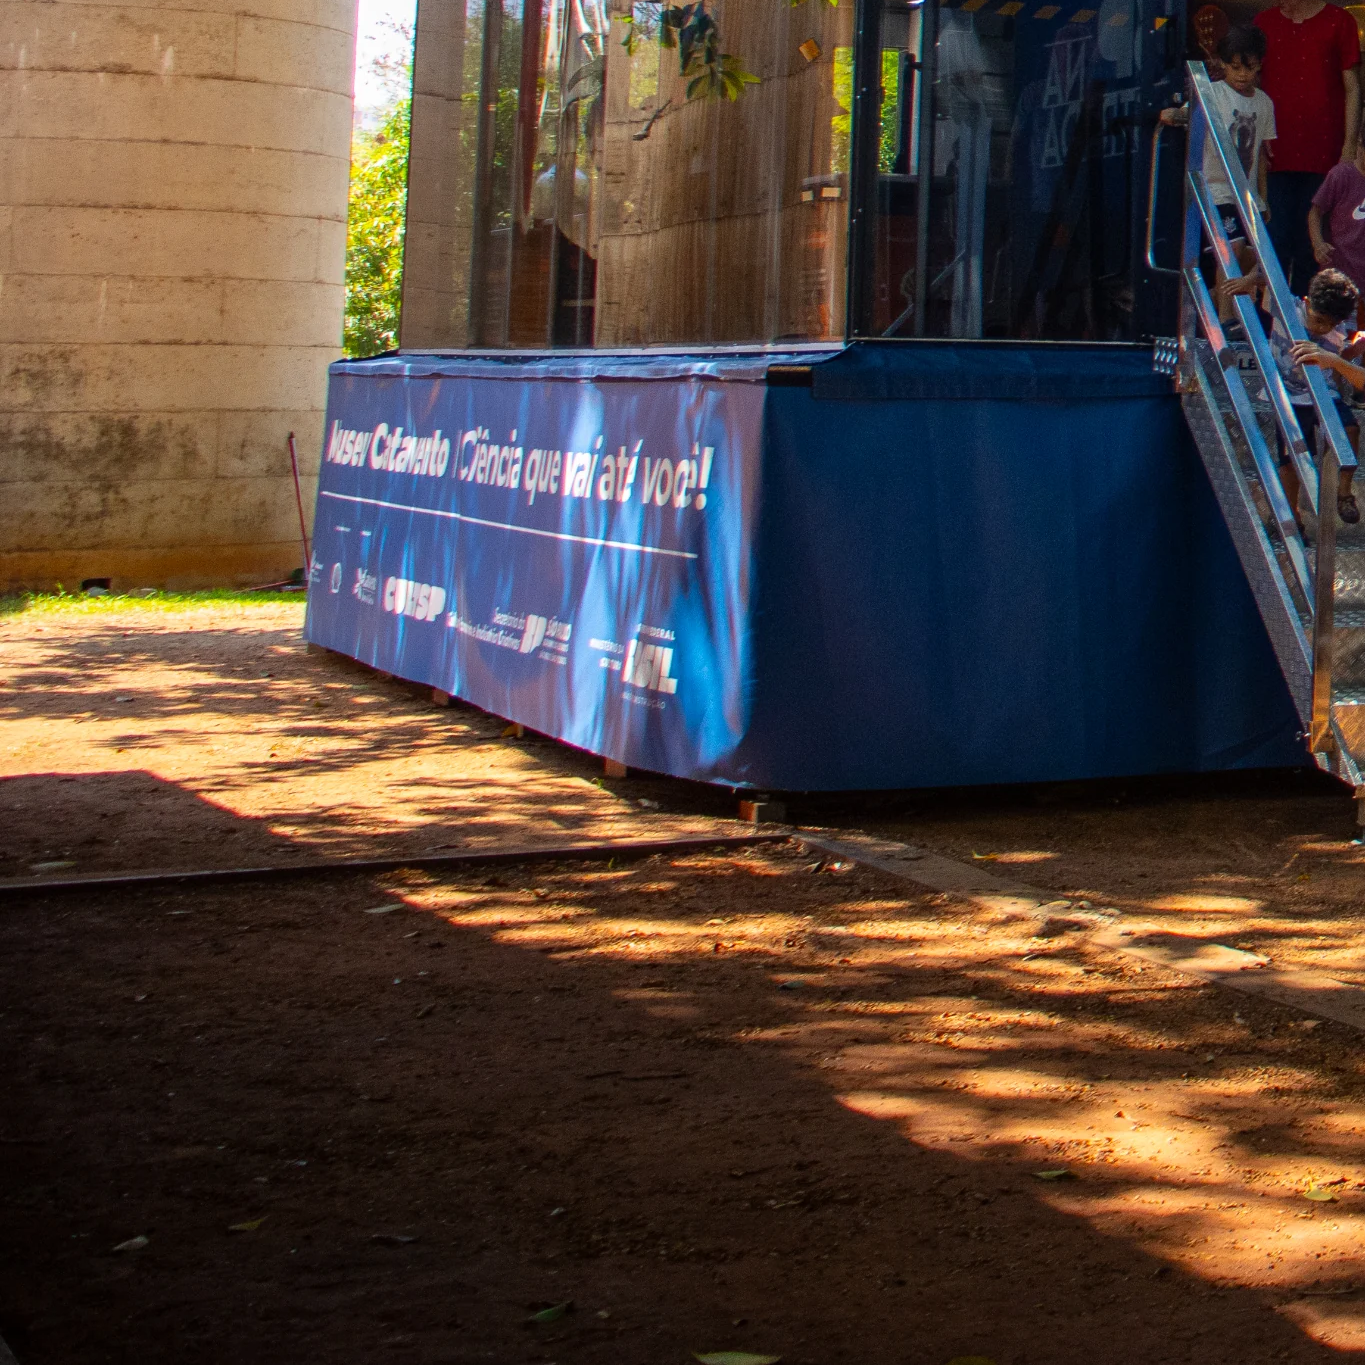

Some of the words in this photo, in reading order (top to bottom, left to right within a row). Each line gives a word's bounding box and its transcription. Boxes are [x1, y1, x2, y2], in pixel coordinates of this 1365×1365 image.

[459, 426, 524, 489] Ciência
[525, 448, 562, 506] que
[562, 435, 604, 499] vai
[599, 439, 644, 503] até
[642, 441, 715, 511] você!
